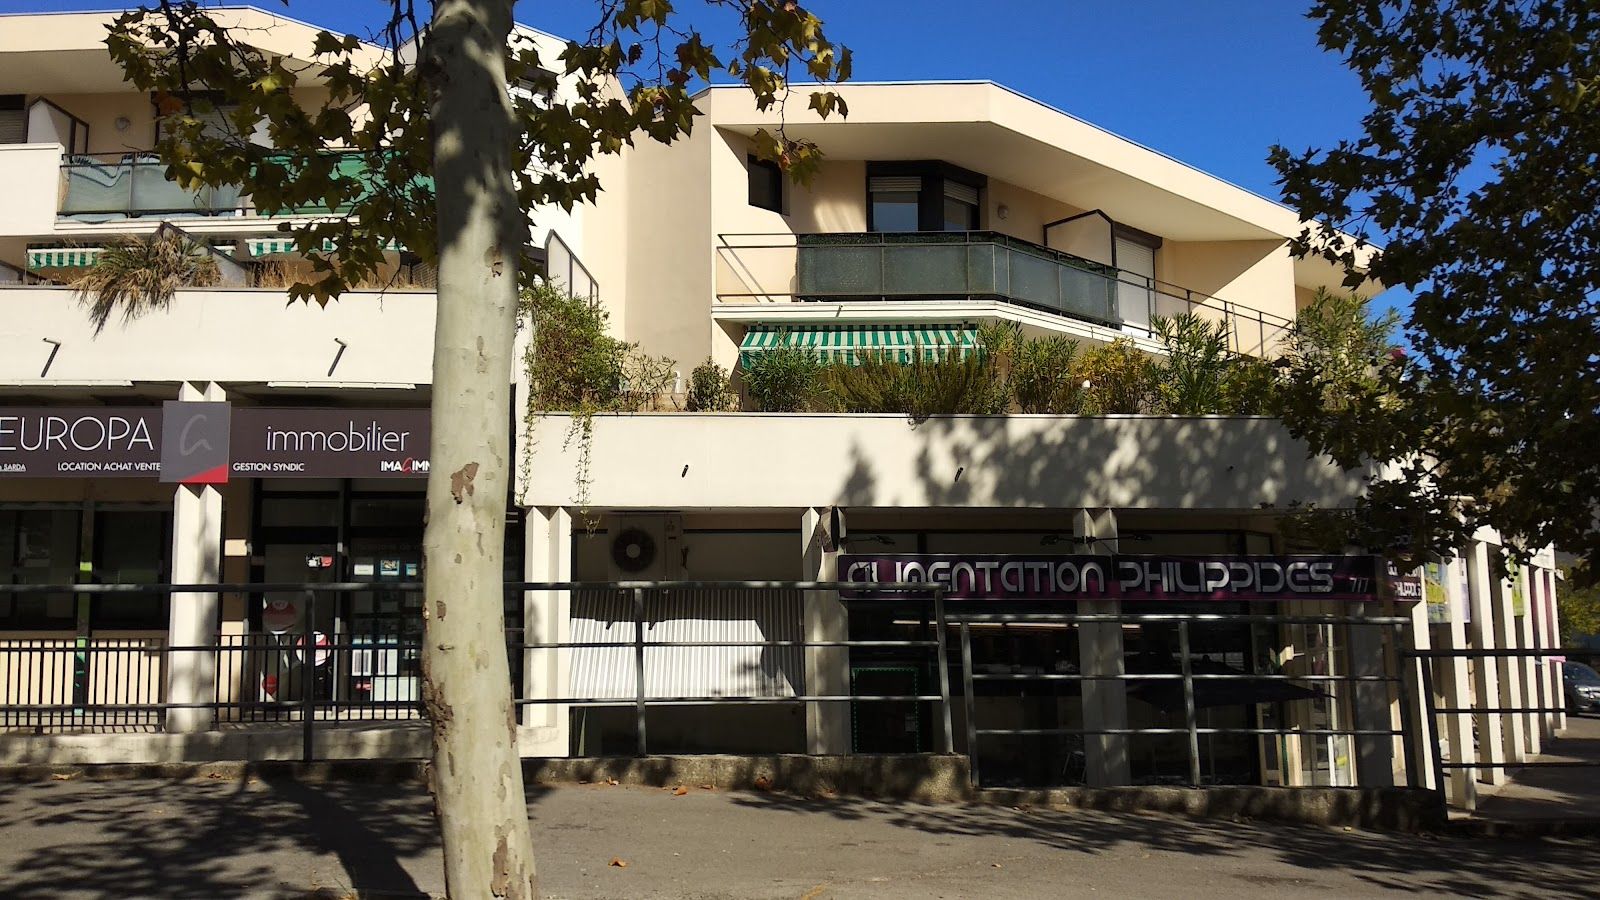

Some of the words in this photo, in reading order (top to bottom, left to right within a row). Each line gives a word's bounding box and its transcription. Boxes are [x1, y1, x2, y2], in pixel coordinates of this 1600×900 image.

[0, 416, 154, 451] EUROPA
[266, 420, 410, 451] immobilier
[4, 463, 26, 473] SARDA
[57, 462, 101, 471] LOCATION
[103, 462, 132, 471] ACHAT
[134, 462, 161, 471] VENTE
[232, 462, 271, 471] GESTION
[273, 462, 305, 472] SYNDIC
[1118, 561, 1334, 593] PHILIPPIDES
